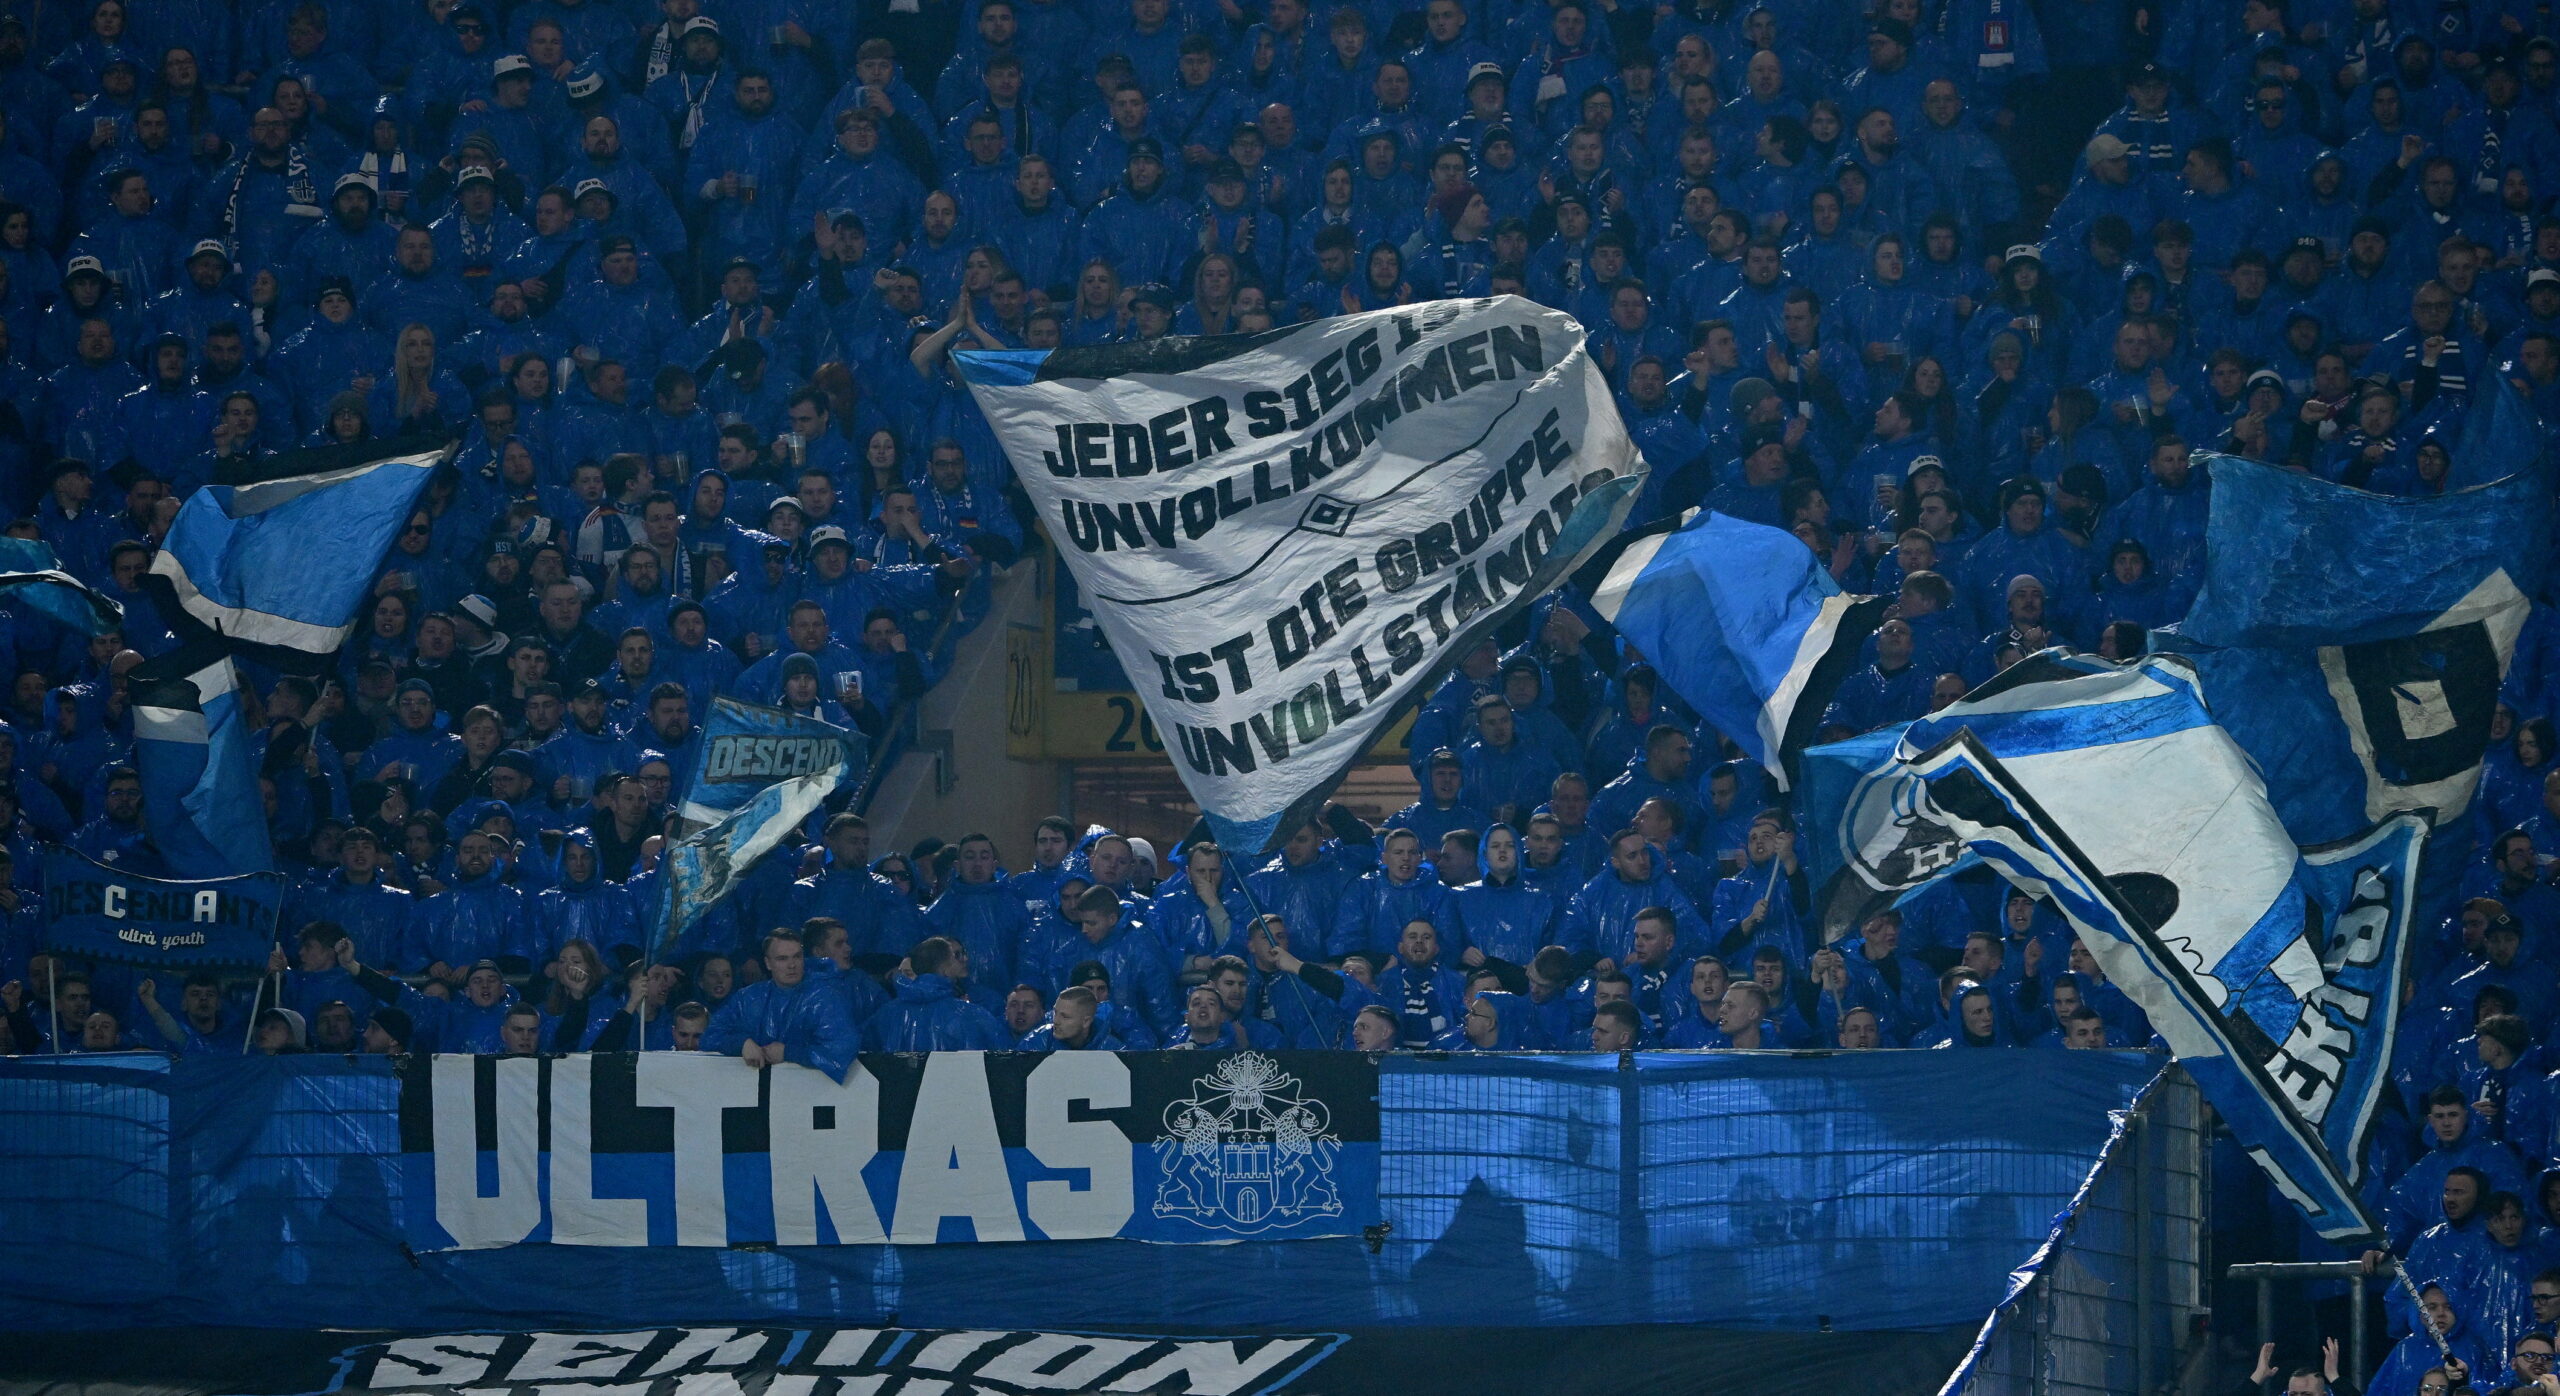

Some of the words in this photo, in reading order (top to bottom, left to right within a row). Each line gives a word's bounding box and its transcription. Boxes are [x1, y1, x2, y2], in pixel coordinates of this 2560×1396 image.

[1043, 395, 1237, 479] JEDER
[1244, 327, 1387, 439] SIEG
[1061, 324, 1543, 552] UNVOLLKOMMEN
[495, 541, 513, 553] HSV
[1149, 633, 1254, 704] IST
[1266, 557, 1368, 672] DIE
[1375, 407, 1573, 593] GRUPPE
[162, 931, 206, 951] youth
[431, 1050, 1135, 1252] ULTRAS
